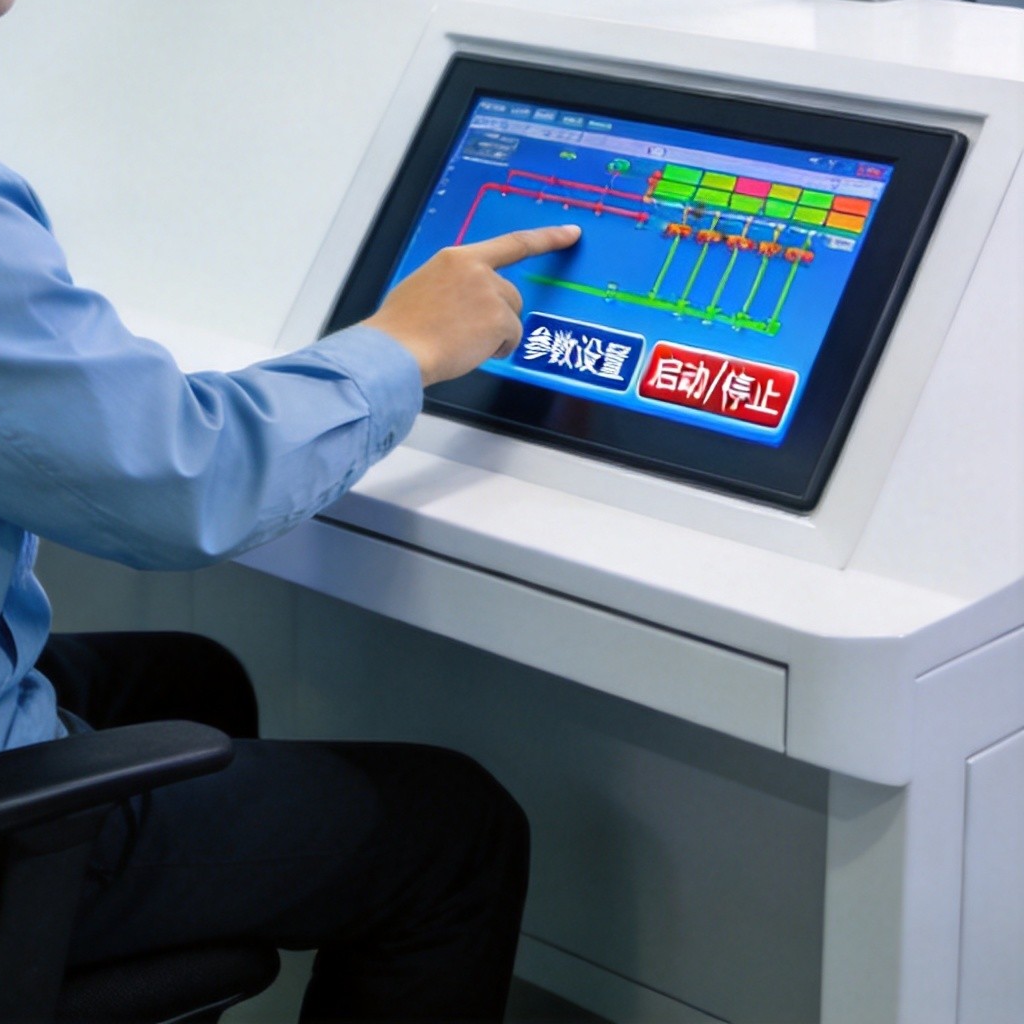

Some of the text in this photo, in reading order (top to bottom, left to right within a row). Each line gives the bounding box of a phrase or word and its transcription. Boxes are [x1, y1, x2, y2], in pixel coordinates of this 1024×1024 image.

[523, 326, 632, 381] 参数设置
[649, 356, 781, 416] 启动/停止
